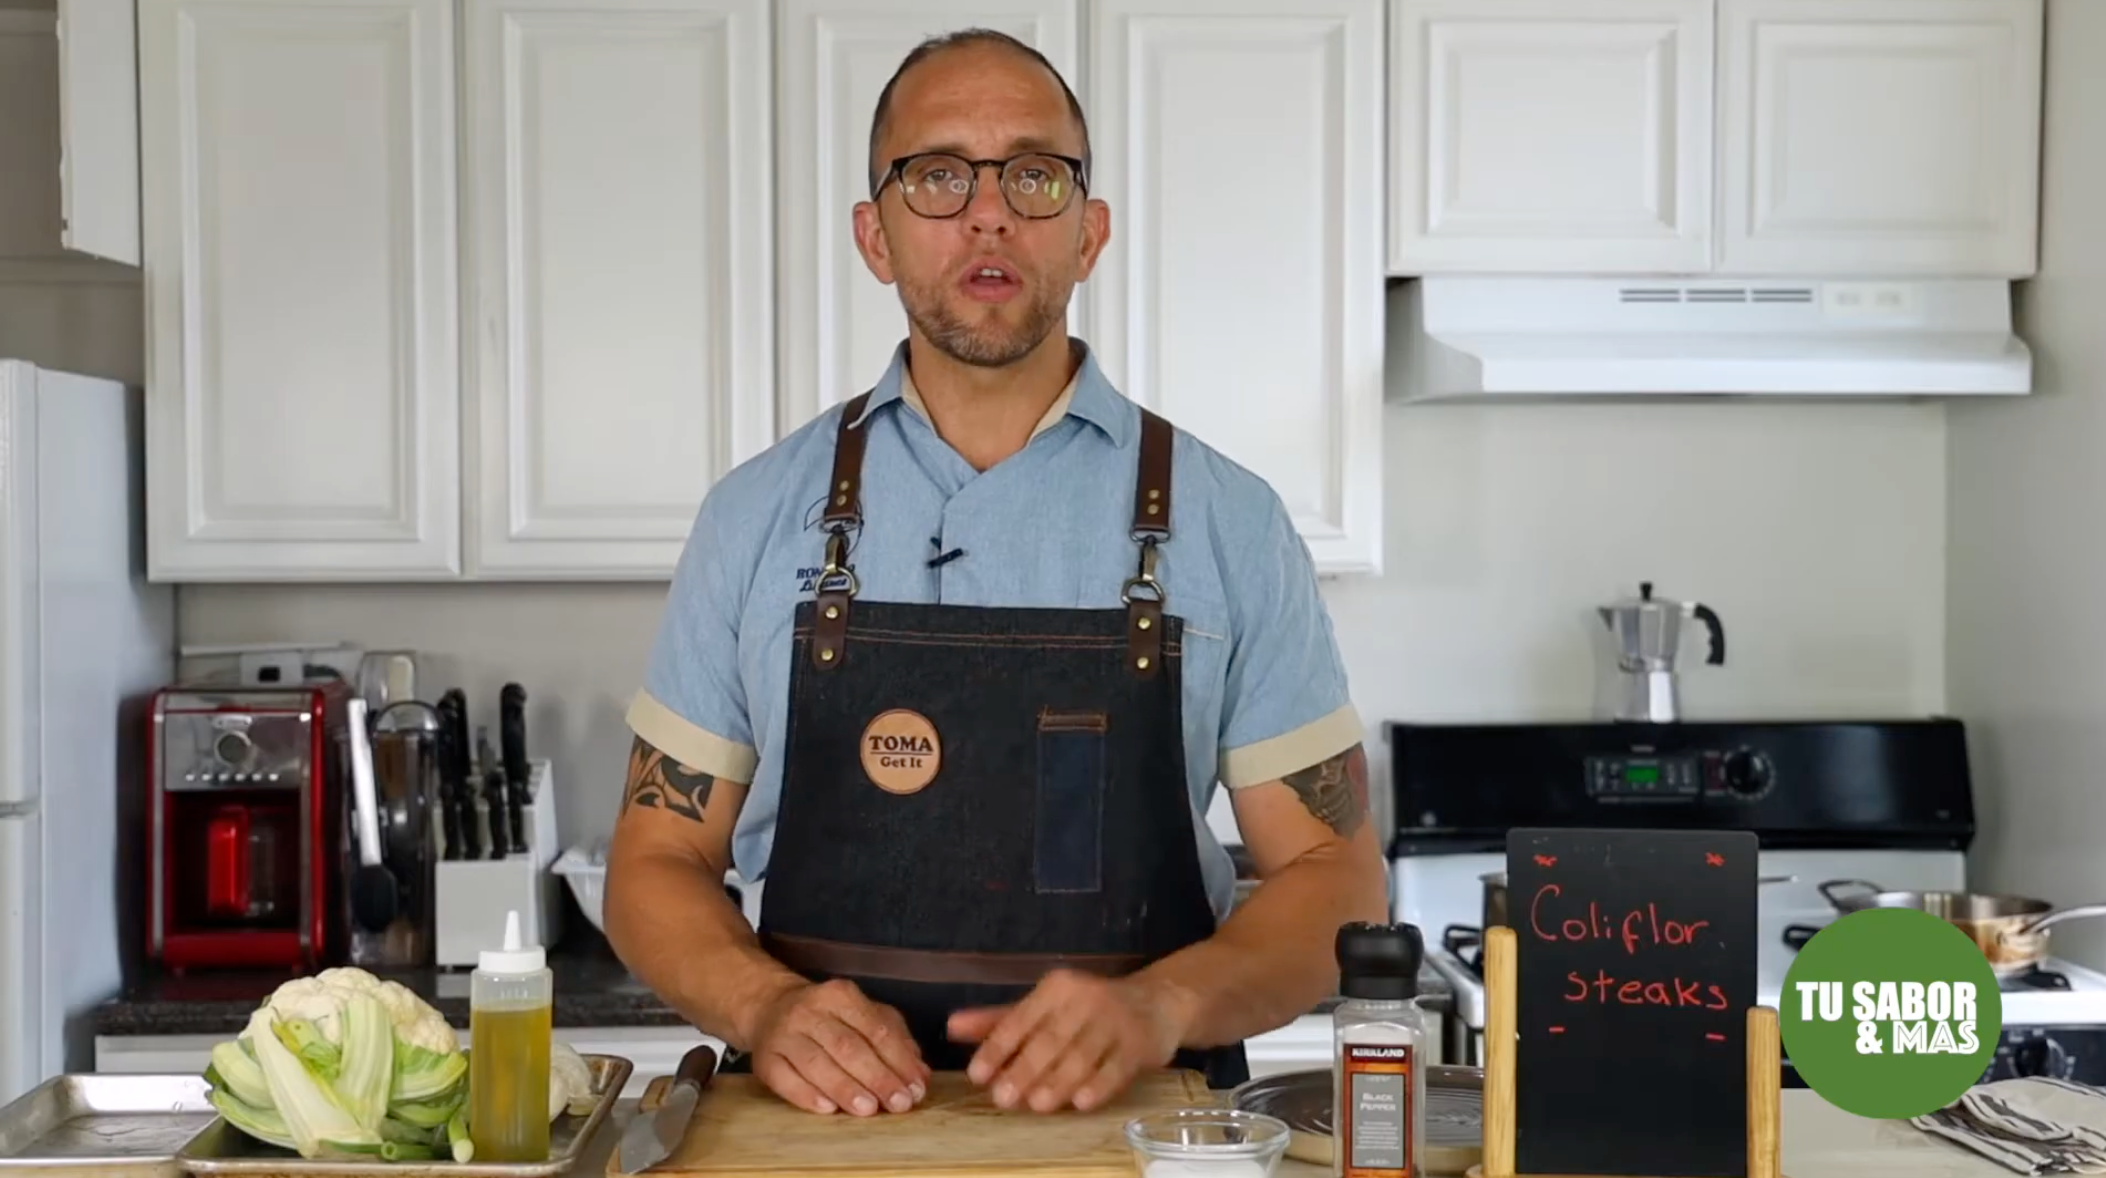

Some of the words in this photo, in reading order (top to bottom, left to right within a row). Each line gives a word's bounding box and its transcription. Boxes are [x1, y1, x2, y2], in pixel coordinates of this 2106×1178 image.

[868, 735, 934, 752] TOMA
[880, 756, 906, 768] Get
[910, 757, 923, 768] It
[1531, 884, 1709, 954] Coliflor
[1564, 969, 1728, 1010] steaks
[1352, 1047, 1405, 1057] KIRKLAND
